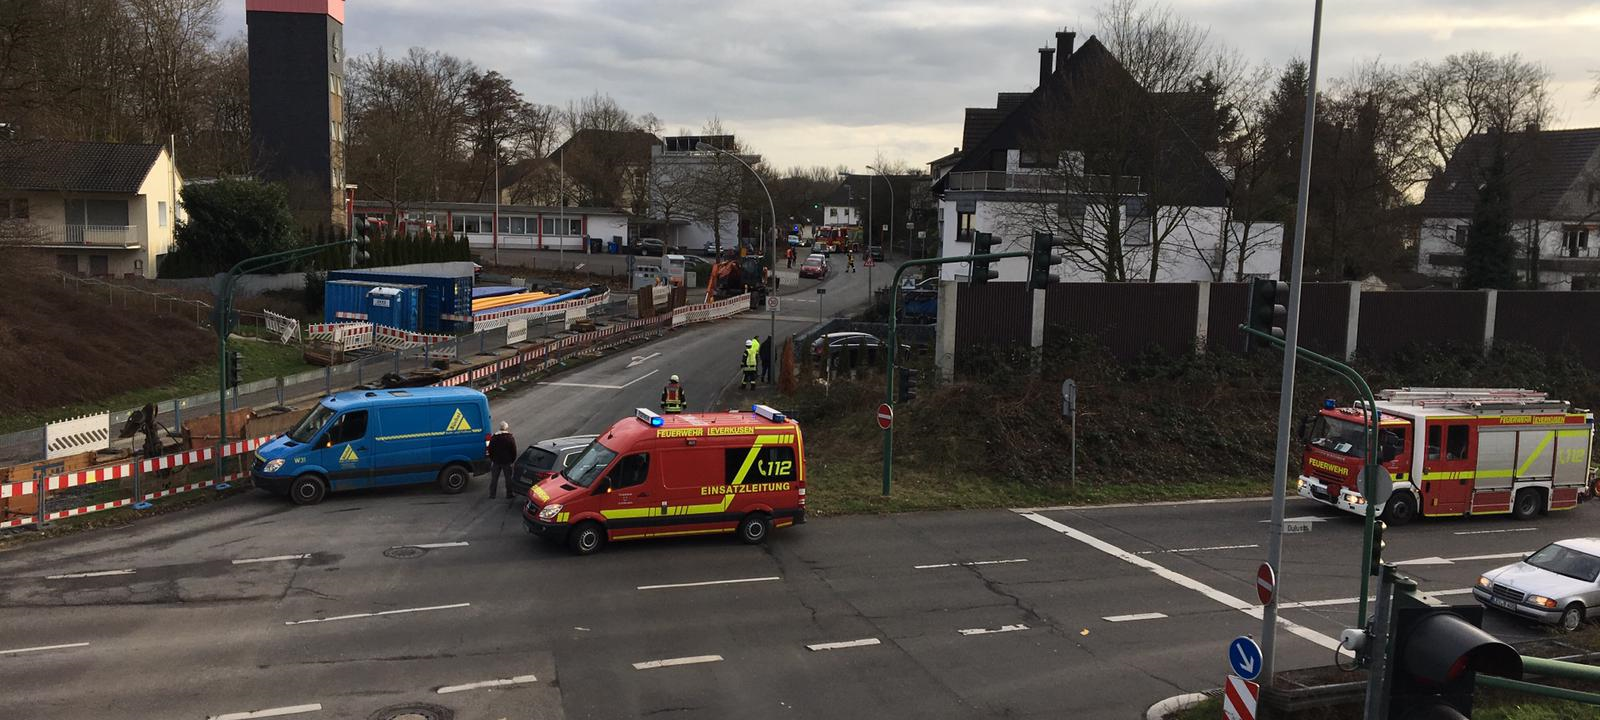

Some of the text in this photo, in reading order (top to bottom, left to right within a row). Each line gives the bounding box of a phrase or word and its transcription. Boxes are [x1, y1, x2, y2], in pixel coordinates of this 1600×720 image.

[656, 425, 755, 438] FEUERWEHR LEVERKUSEN
[1566, 448, 1585, 463] 112
[767, 460, 792, 476] 112
[1308, 457, 1349, 476] FEUERWEHR
[700, 482, 791, 496] EINSATZLEITUNG
